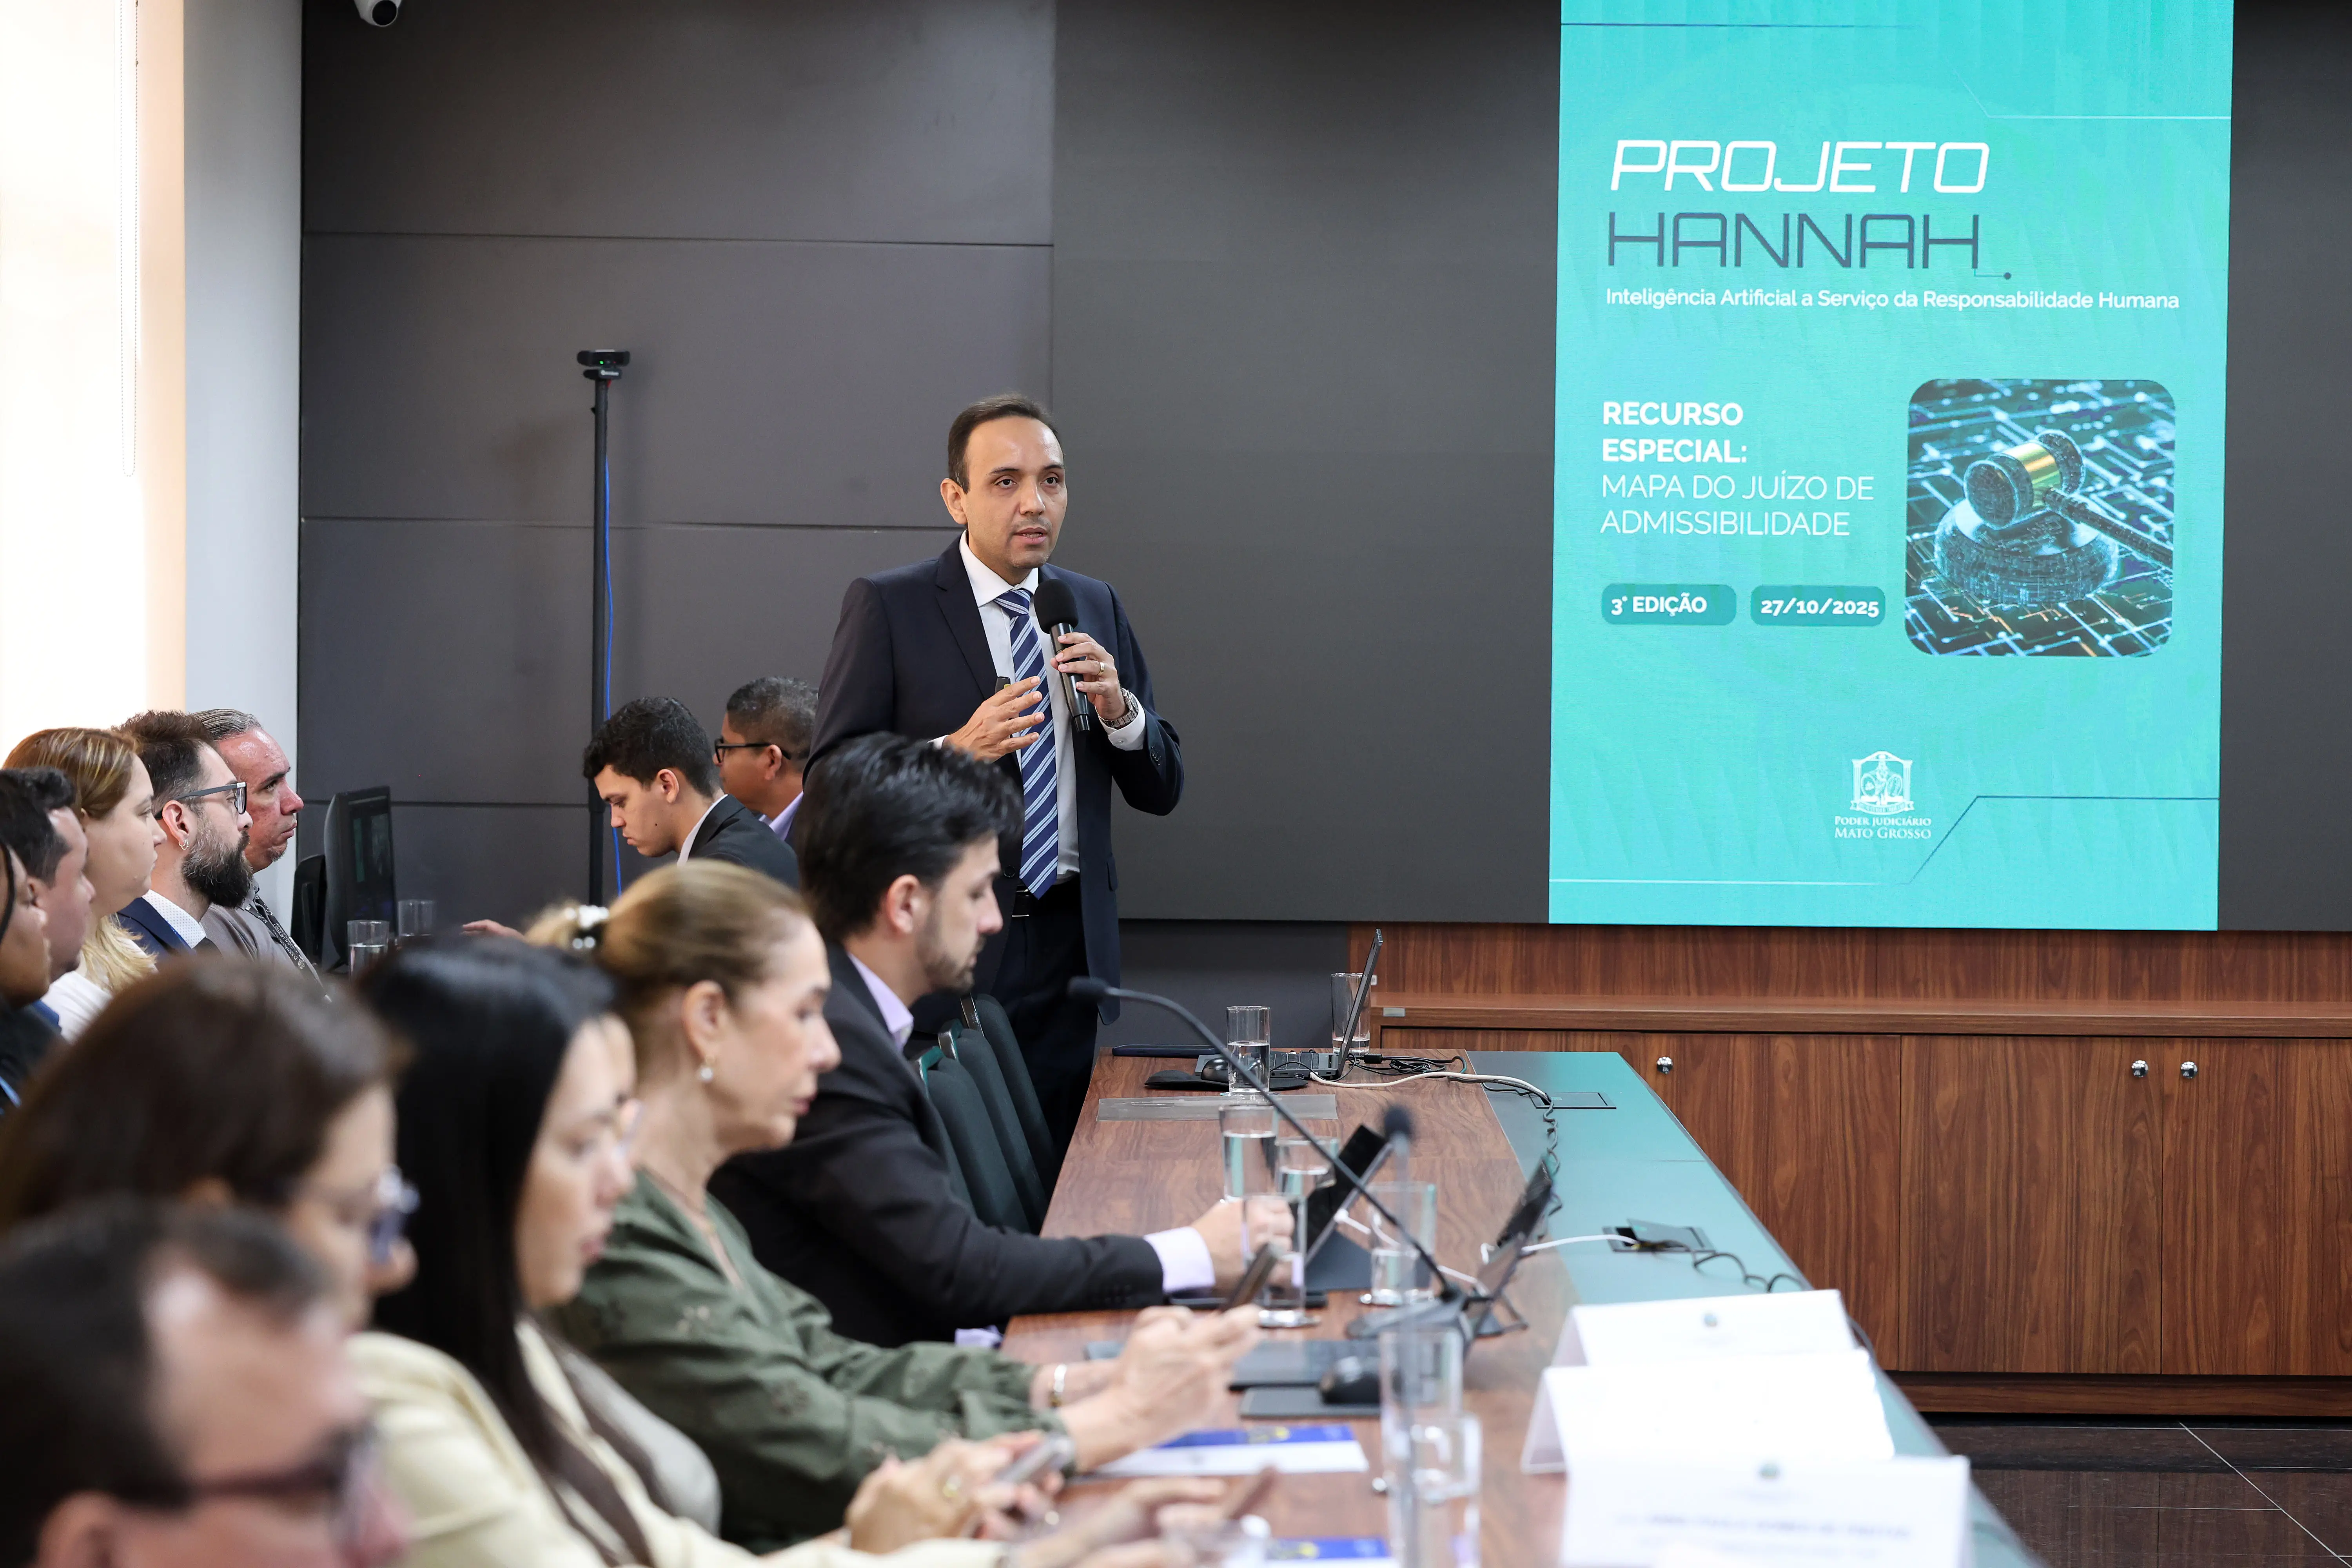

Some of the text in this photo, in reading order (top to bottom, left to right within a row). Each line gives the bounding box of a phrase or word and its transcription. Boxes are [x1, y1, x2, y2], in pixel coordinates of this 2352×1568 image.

[1610, 140, 1990, 194] PROJETO
[1608, 212, 1979, 269] HANNAH
[1606, 288, 2180, 312] Inteligência Artificial a Serviço da Responsabilidade Humana
[1602, 401, 1744, 426] RECURSO
[1602, 438, 1747, 463] ESPECIAL:
[1602, 469, 1875, 500] MAPA DO JUÍZO DE
[1600, 510, 1850, 536] ADMISSIBILIDADE
[1632, 593, 1707, 616] EDIÇÃO
[1760, 597, 1879, 618] 27/10/2025
[1835, 815, 1932, 827] PODER JUDICIÁRIO
[1835, 827, 1932, 839] MATO GROSSO
